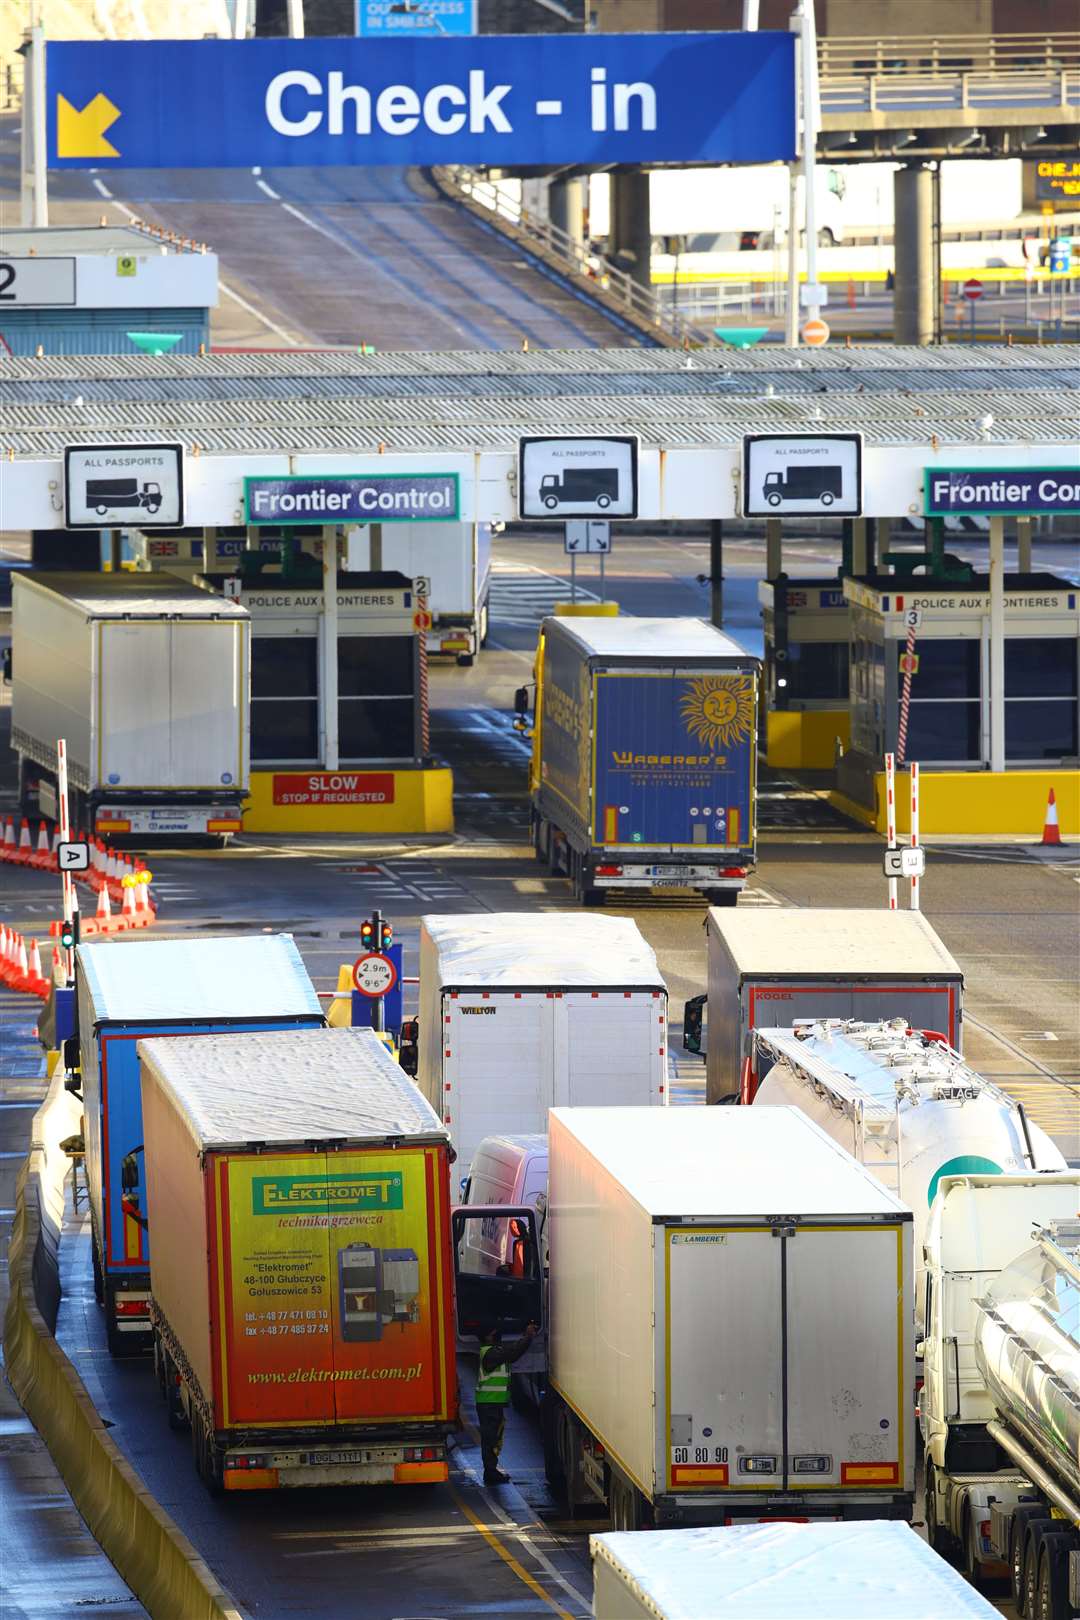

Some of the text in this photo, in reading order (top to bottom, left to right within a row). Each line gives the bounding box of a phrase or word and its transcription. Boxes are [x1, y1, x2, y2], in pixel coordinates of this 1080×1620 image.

[265, 69, 513, 137] Check
[591, 67, 657, 132] in
[84, 457, 164, 467] ALL PASSPORTS
[934, 480, 1032, 503] Frontier
[254, 486, 451, 512] Frontier Control
[229, 582, 236, 594] 1
[416, 580, 426, 594] 2
[249, 596, 394, 607] POLICE AUX ONTIERES
[914, 597, 1058, 608] POLICE AUX FONTIERES
[908, 612, 917, 625] 3
[309, 776, 358, 790] SLOW
[282, 792, 385, 803] STOP IF REQUESTED
[67, 850, 80, 862] A
[908, 856, 918, 866] E
[890, 858, 902, 868] D
[363, 963, 386, 972] 2.9m
[461, 1006, 496, 1015] WIELTON
[950, 1087, 973, 1099] LAG
[263, 1179, 393, 1208] ELEKTROMET
[278, 1214, 384, 1228] technika grzewcza
[684, 1235, 726, 1243] LAMBERET
[253, 1262, 313, 1273] "Elektromet"
[244, 1275, 274, 1285] 48-100
[311, 1286, 322, 1295] 53
[245, 1327, 257, 1336] fax
[278, 1326, 289, 1335] 77
[247, 1362, 423, 1385] www.elektromet.com.pl
[695, 1447, 708, 1463] 80
[715, 1447, 729, 1463] 90
